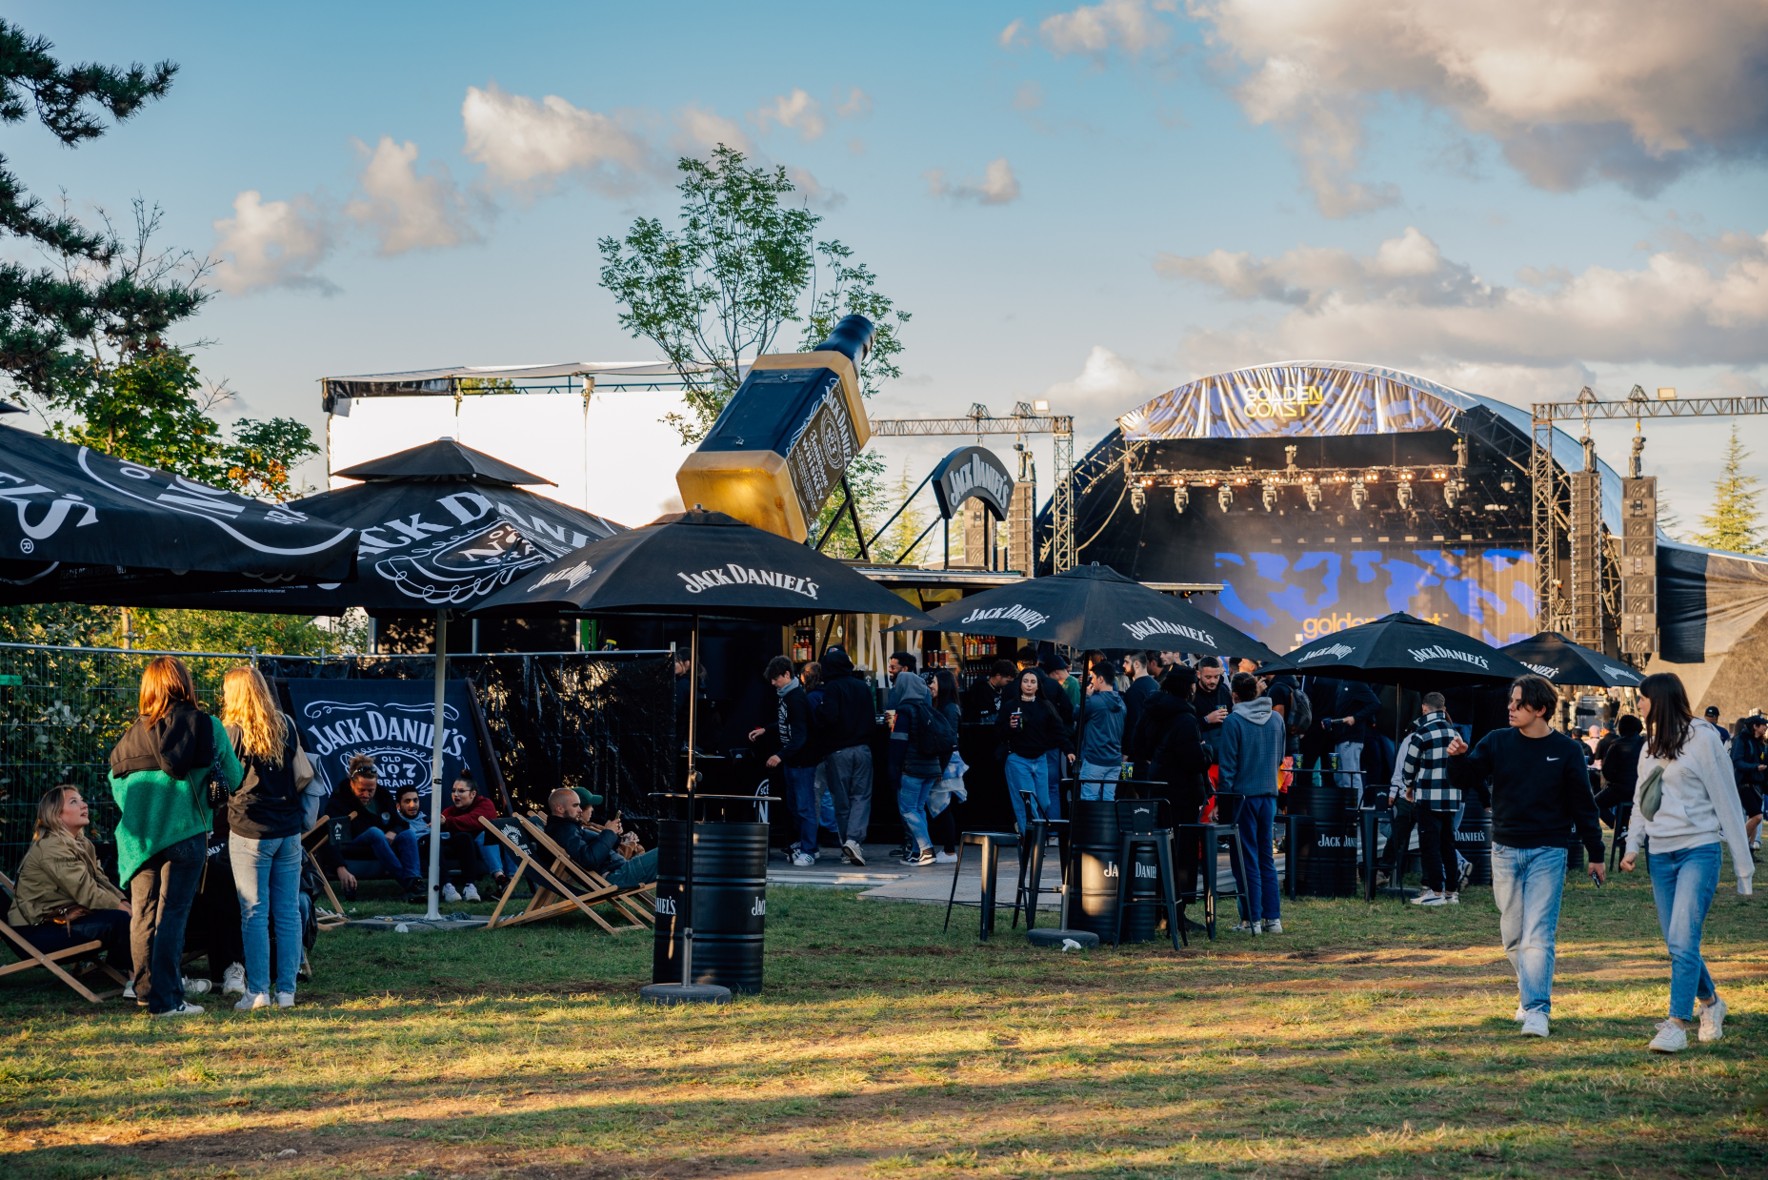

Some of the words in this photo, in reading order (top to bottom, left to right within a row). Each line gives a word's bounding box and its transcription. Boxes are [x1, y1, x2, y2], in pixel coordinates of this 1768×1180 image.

[949, 462, 974, 507] JACK
[972, 453, 1009, 509] DANIEL'S
[677, 569, 733, 594] JACK
[726, 563, 819, 599] DANIEL'S
[962, 607, 1003, 624] JACK
[1000, 603, 1050, 632] DANIEL'S
[1122, 617, 1152, 641] JACK
[1148, 616, 1218, 649] DANIEL'S
[1407, 648, 1437, 663] JACK
[1433, 644, 1490, 671] DANIEL'S
[308, 717, 370, 755] JACK
[403, 763, 417, 778] 7
[1317, 833, 1341, 847] JACK
[1454, 829, 1485, 842] DANIEL'S
